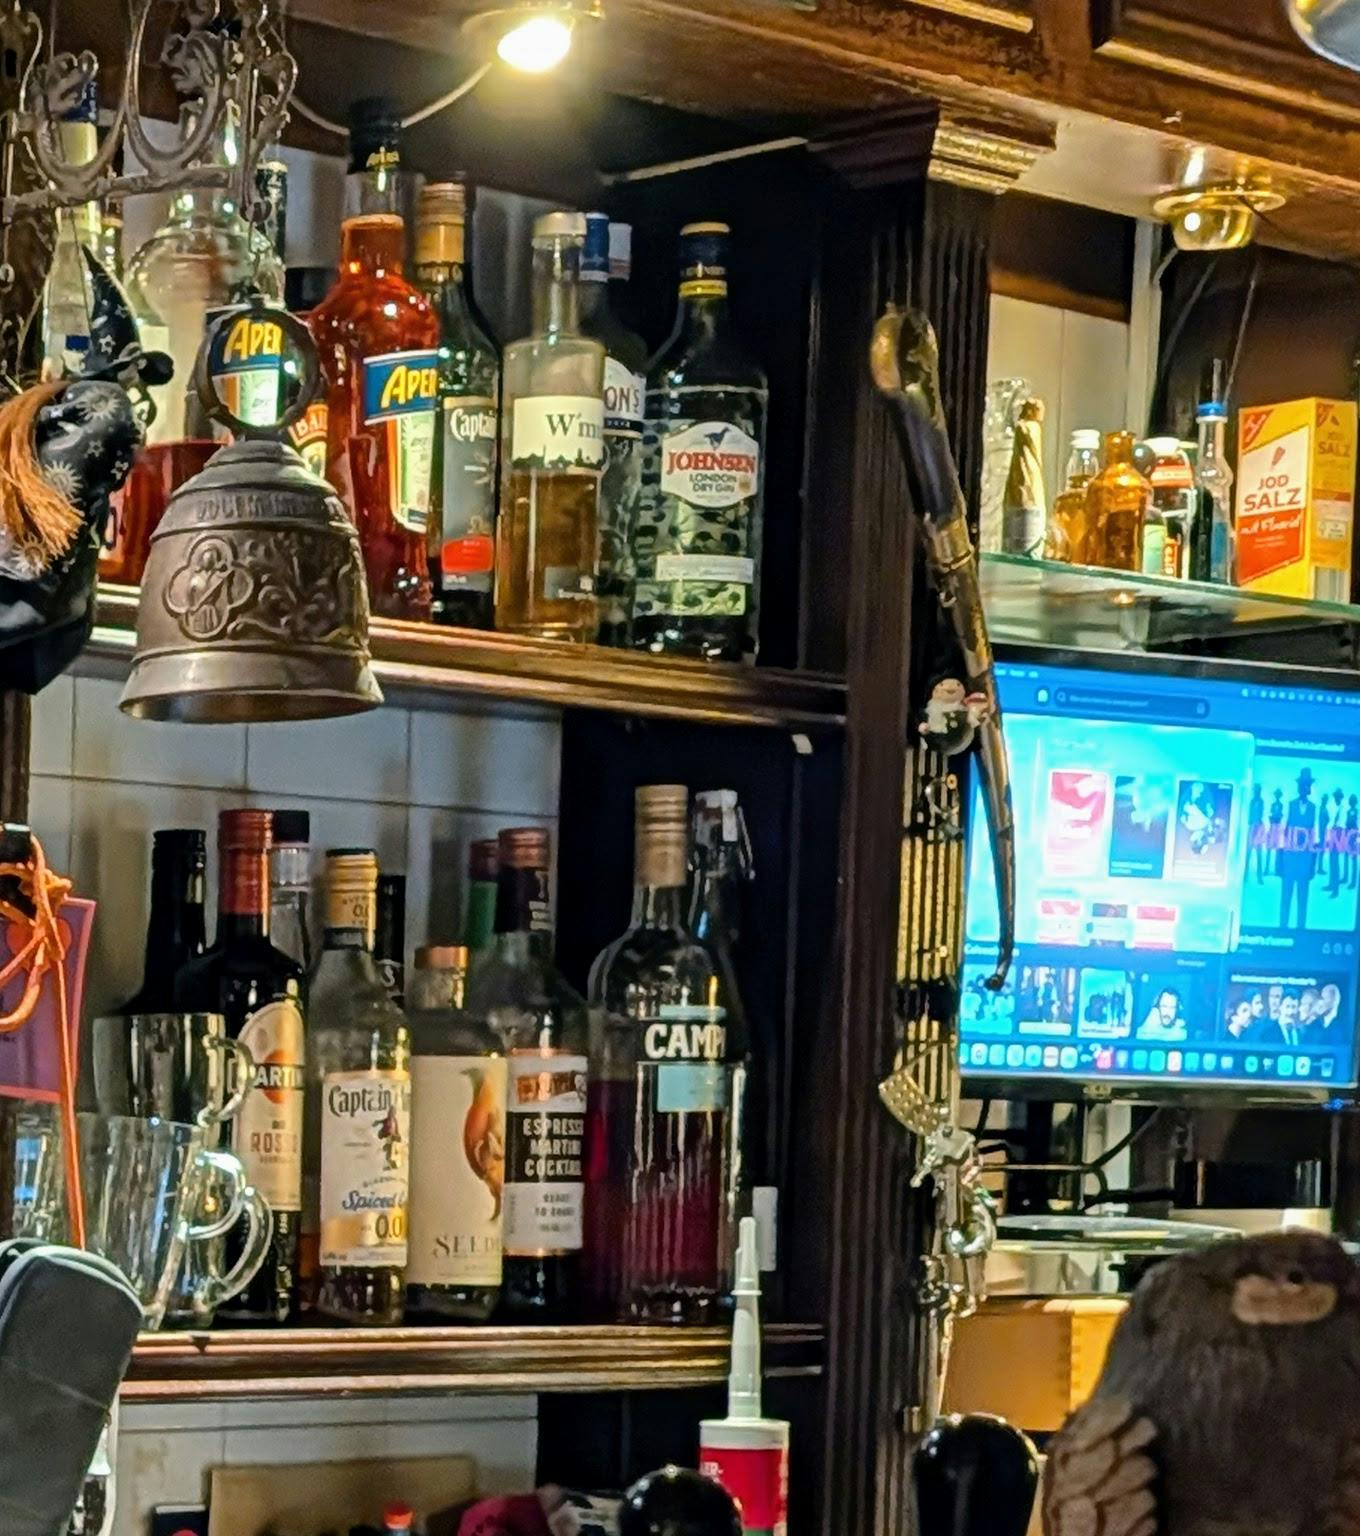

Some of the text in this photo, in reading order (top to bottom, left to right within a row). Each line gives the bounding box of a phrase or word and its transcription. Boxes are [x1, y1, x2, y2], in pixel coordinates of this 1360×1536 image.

[1317, 442, 1351, 459] SALZ
[666, 452, 756, 475] JOHNSEN
[689, 473, 737, 484] LONDON
[1257, 474, 1290, 490] JOD
[692, 482, 714, 493] DRY
[1243, 487, 1302, 513] SALZ
